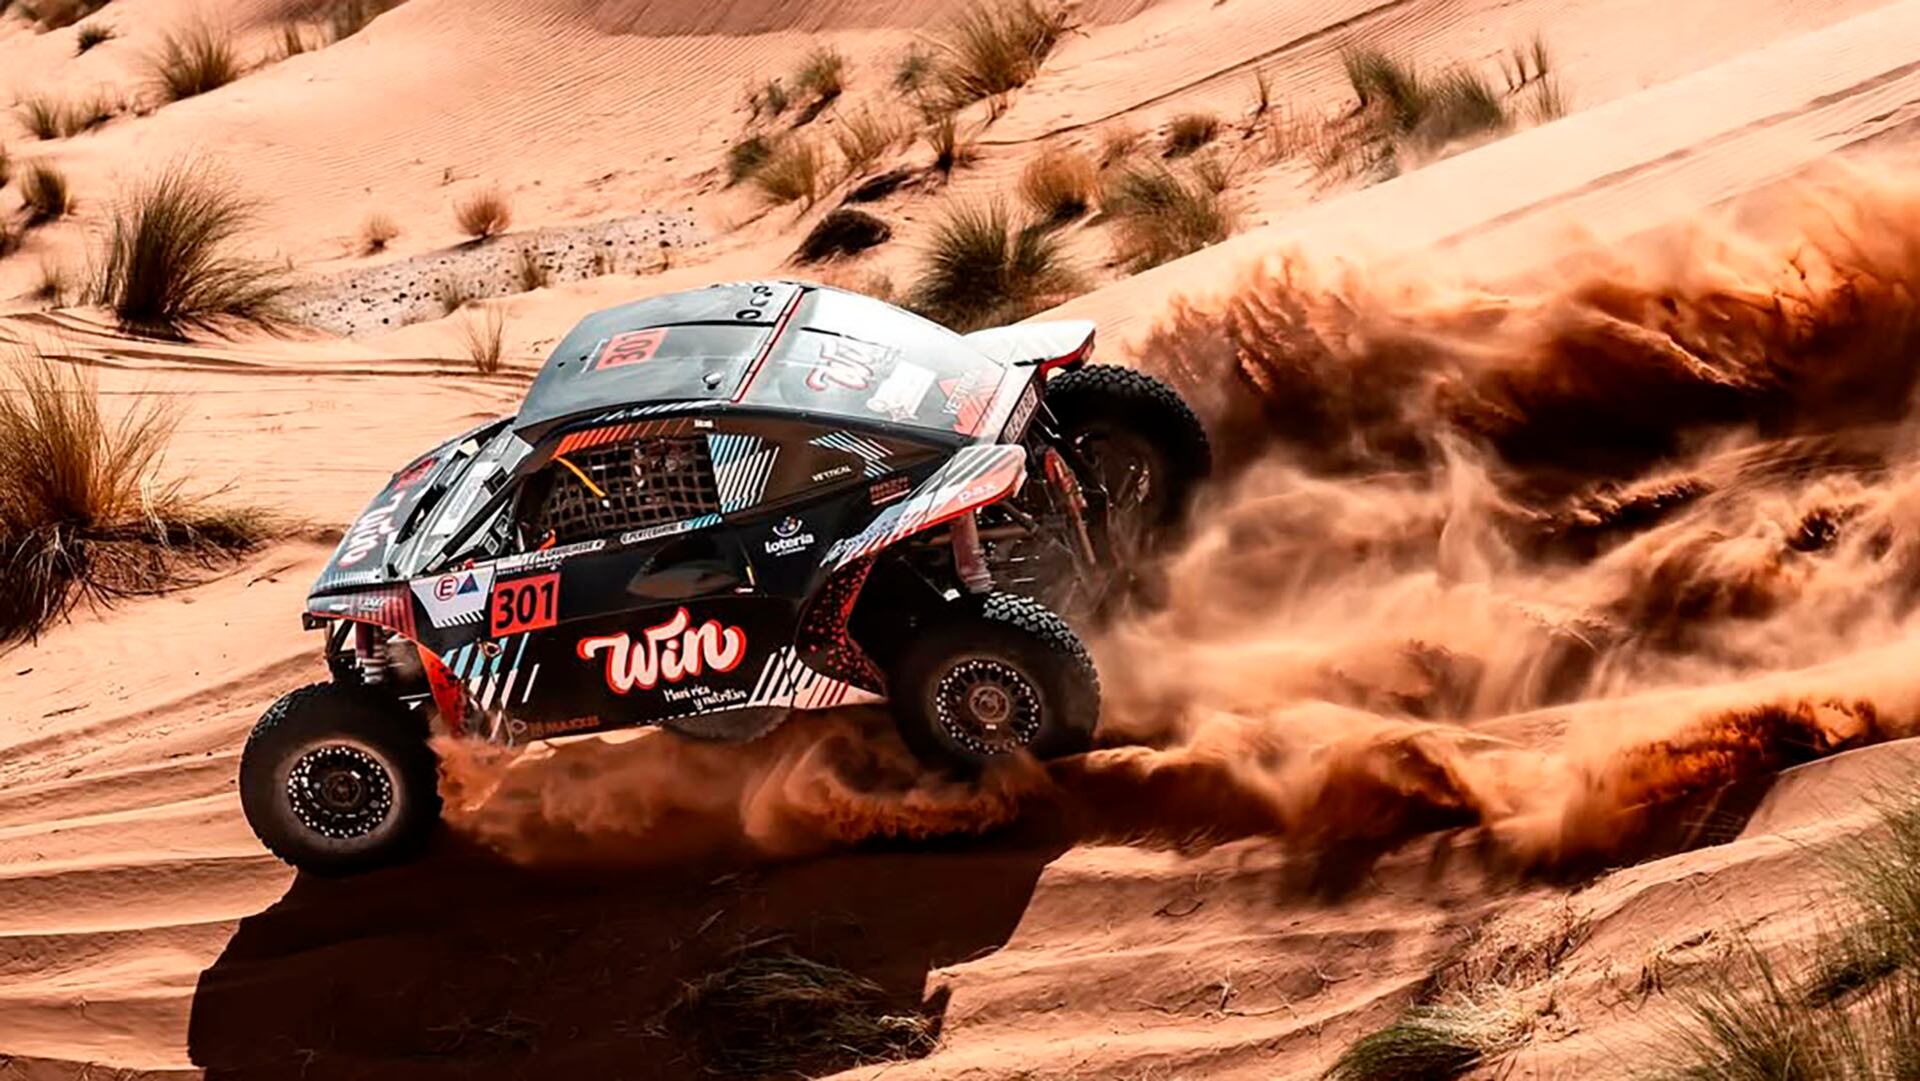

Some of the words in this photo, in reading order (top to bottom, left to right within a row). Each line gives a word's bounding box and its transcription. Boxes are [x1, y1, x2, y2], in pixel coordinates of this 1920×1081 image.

[604, 330, 661, 366] 301
[495, 580, 556, 630] 301
[576, 606, 747, 695] Win
